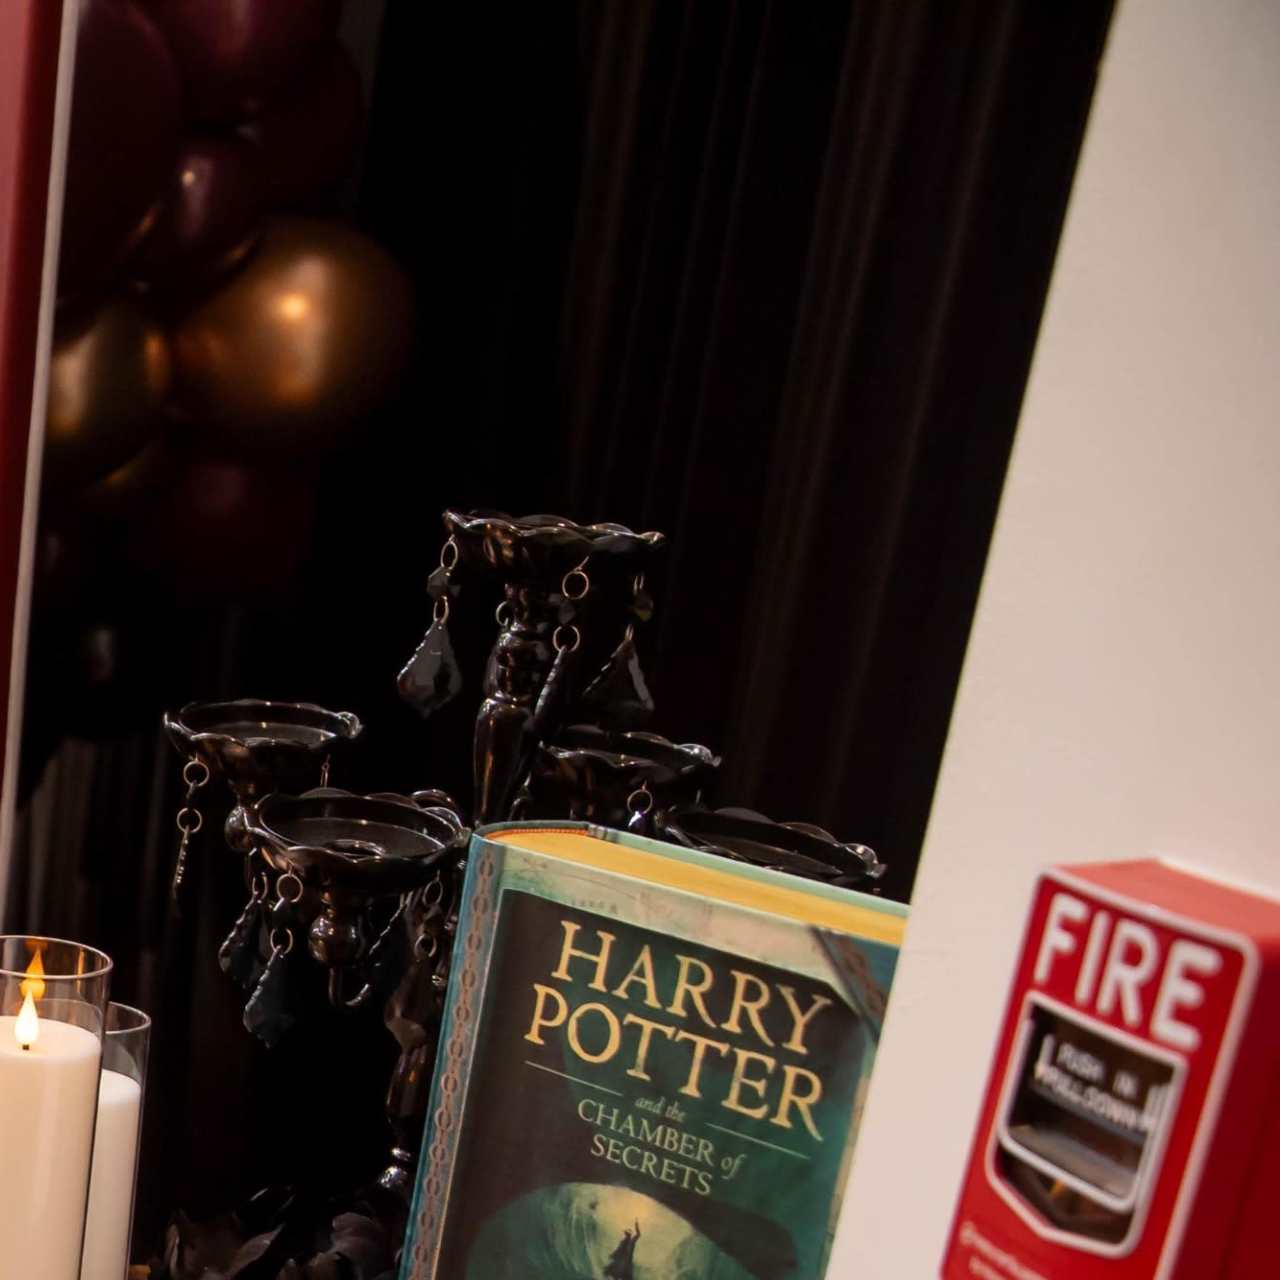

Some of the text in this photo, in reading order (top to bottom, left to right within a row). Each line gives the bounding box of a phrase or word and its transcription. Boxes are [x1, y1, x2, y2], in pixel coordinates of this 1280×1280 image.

[551, 920, 833, 1055] HARRY
[1033, 891, 1224, 1049] FIRE
[524, 983, 824, 1143] POTTER
[634, 1096, 687, 1123] and the
[577, 1098, 748, 1180] CHAMBER of
[590, 1133, 713, 1196] SECRETS
